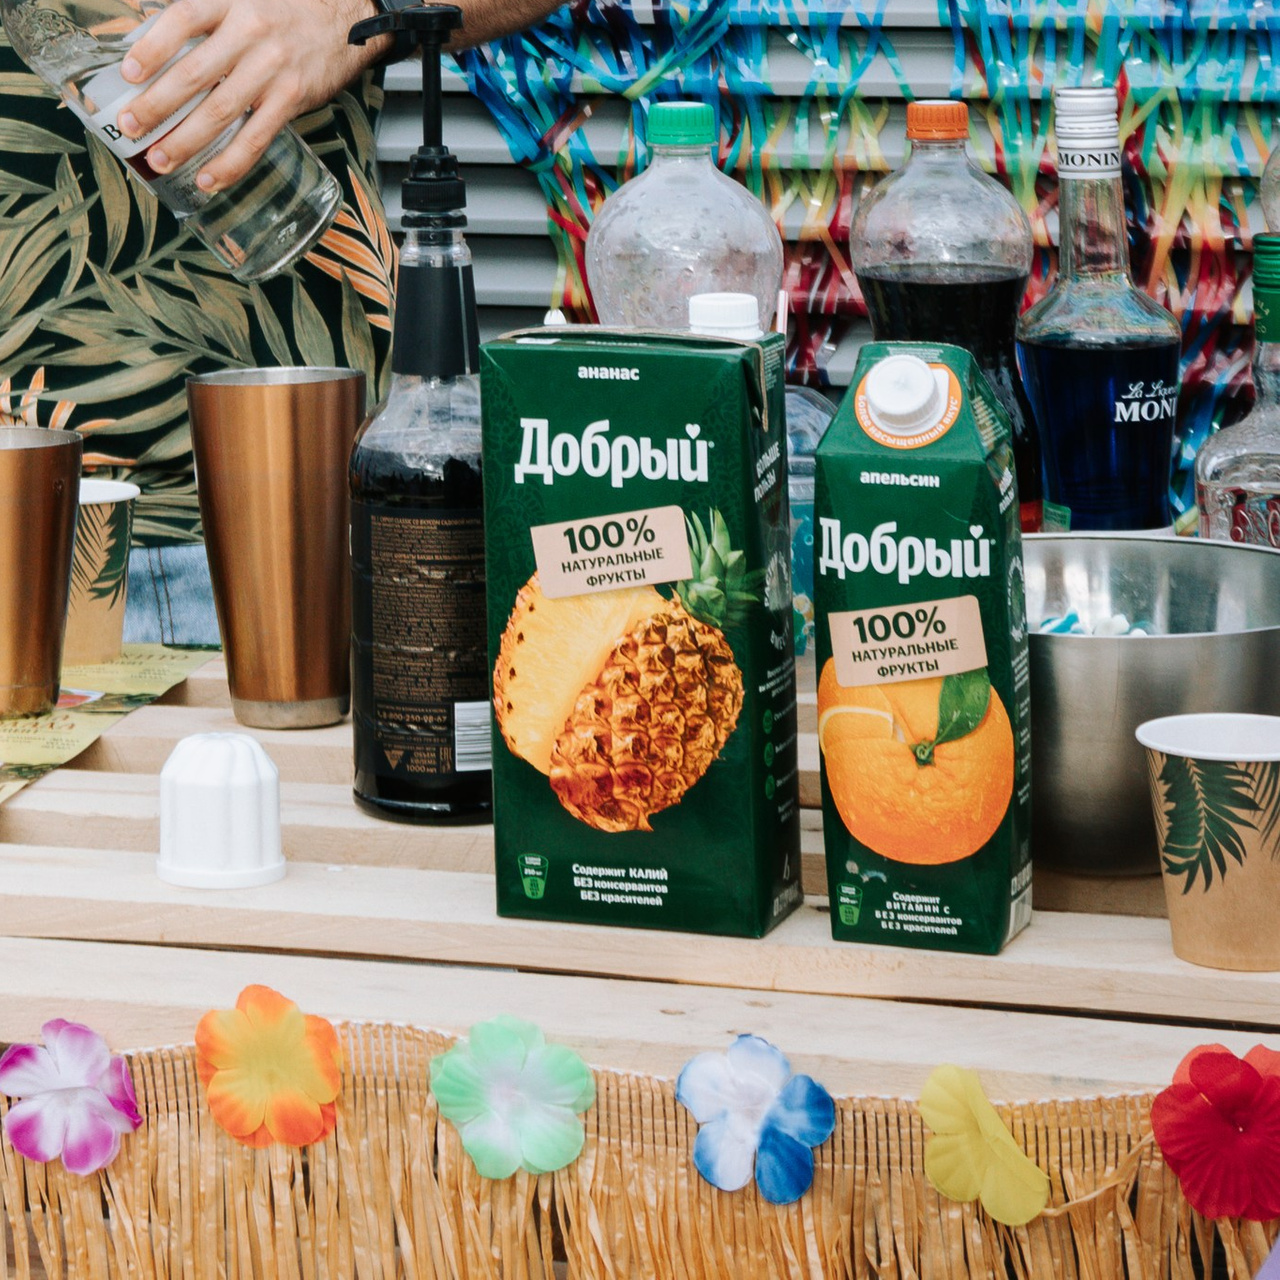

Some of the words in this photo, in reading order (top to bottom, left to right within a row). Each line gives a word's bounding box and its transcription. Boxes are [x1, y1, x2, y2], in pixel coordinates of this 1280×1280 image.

[1059, 151, 1119, 167] MONIN
[577, 365, 640, 381] ананас
[1121, 381, 1144, 399] La
[868, 419, 944, 448] насыщенный
[514, 417, 710, 488] Добрый
[859, 470, 940, 488] апельсин
[563, 515, 656, 555] 100%
[819, 516, 991, 585] Добрый
[561, 547, 664, 573] НАТУРАЛЬНЫЕ
[586, 568, 647, 588] ФРУКТЫ
[853, 606, 947, 644] 100%
[851, 638, 959, 663] НАТУРАЛЬНЫЕ
[877, 659, 940, 678] ФРУКТЫ
[572, 863, 626, 878] Содержит
[629, 867, 669, 881] КАЛИЙ
[573, 876, 593, 888] БЕЗ
[594, 879, 669, 894] консервантов
[580, 889, 600, 902] БЕЗ
[601, 893, 664, 907] красителей
[885, 900, 940, 913] ВИТАМИН
[892, 891, 941, 905] Содержит
[874, 910, 895, 920] БЕЗ
[897, 913, 963, 926] консервантов
[881, 920, 901, 930] БЕЗ
[903, 923, 958, 936] красителей
